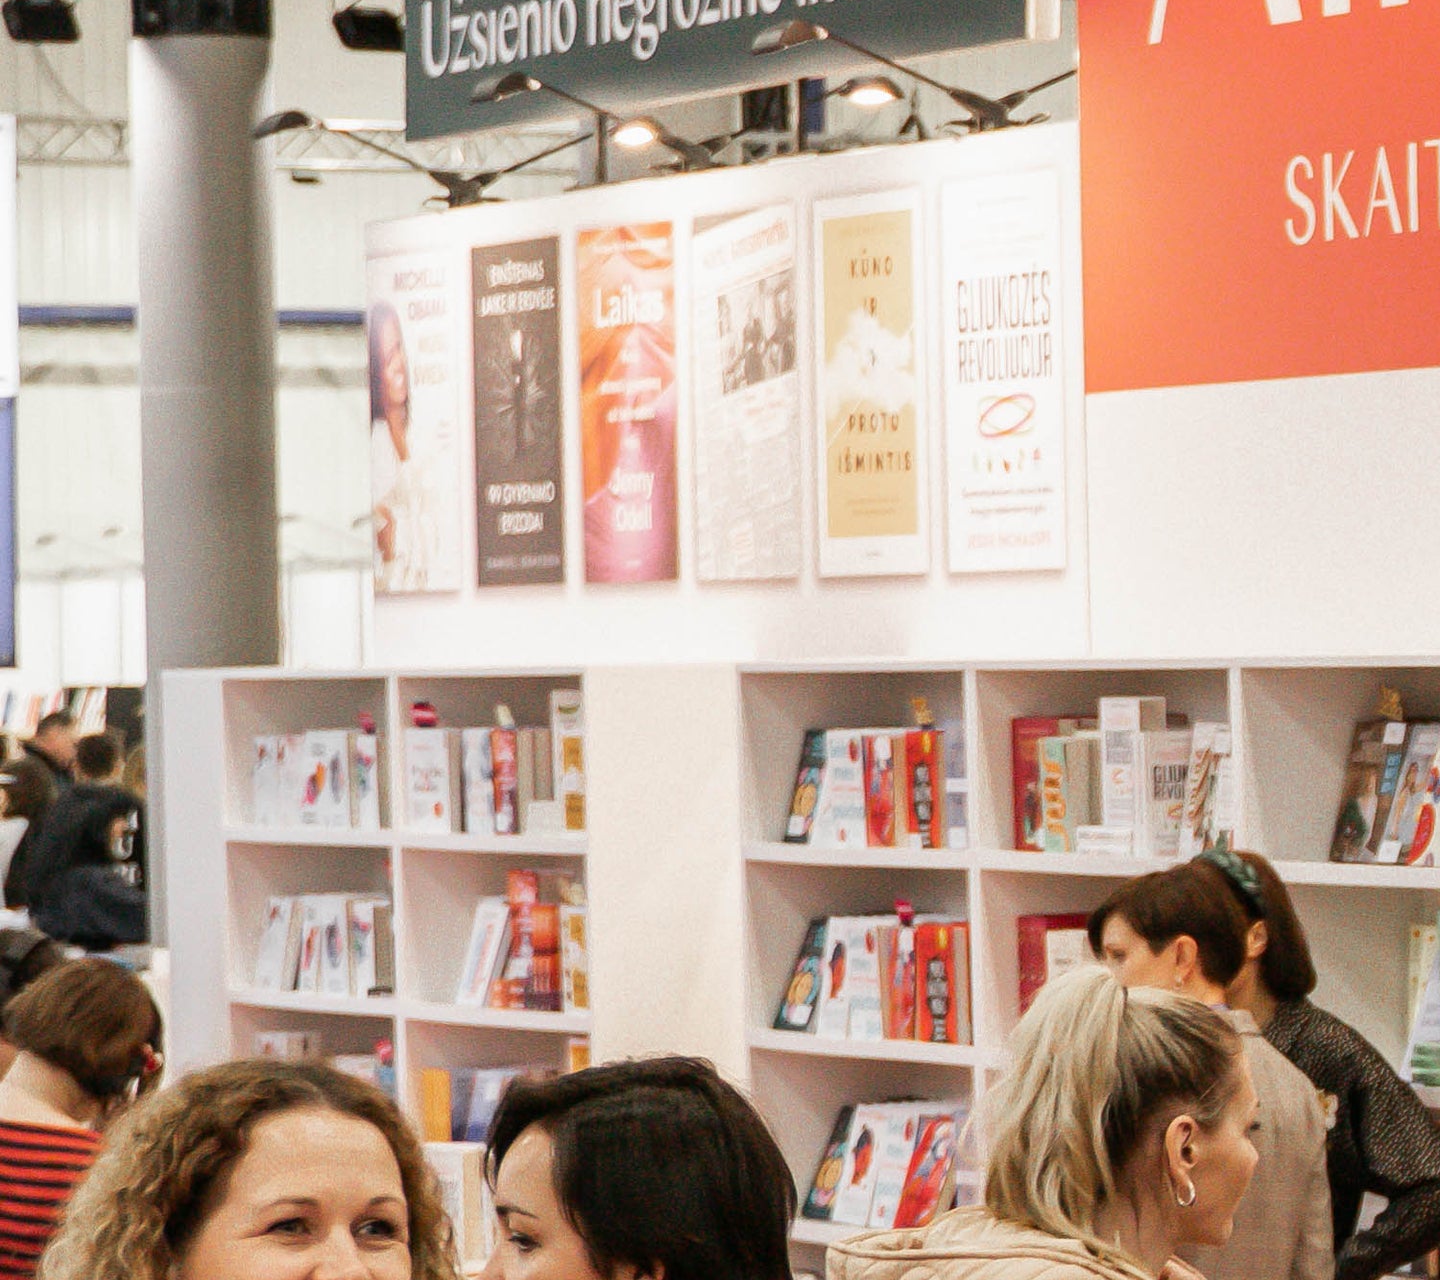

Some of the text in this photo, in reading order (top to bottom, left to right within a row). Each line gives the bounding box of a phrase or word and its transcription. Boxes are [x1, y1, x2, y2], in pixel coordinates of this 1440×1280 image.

[595, 283, 664, 329] Laikas
[957, 263, 1053, 333] GLIUKOZĖS
[957, 332, 1054, 384] REVOLIUCIJA
